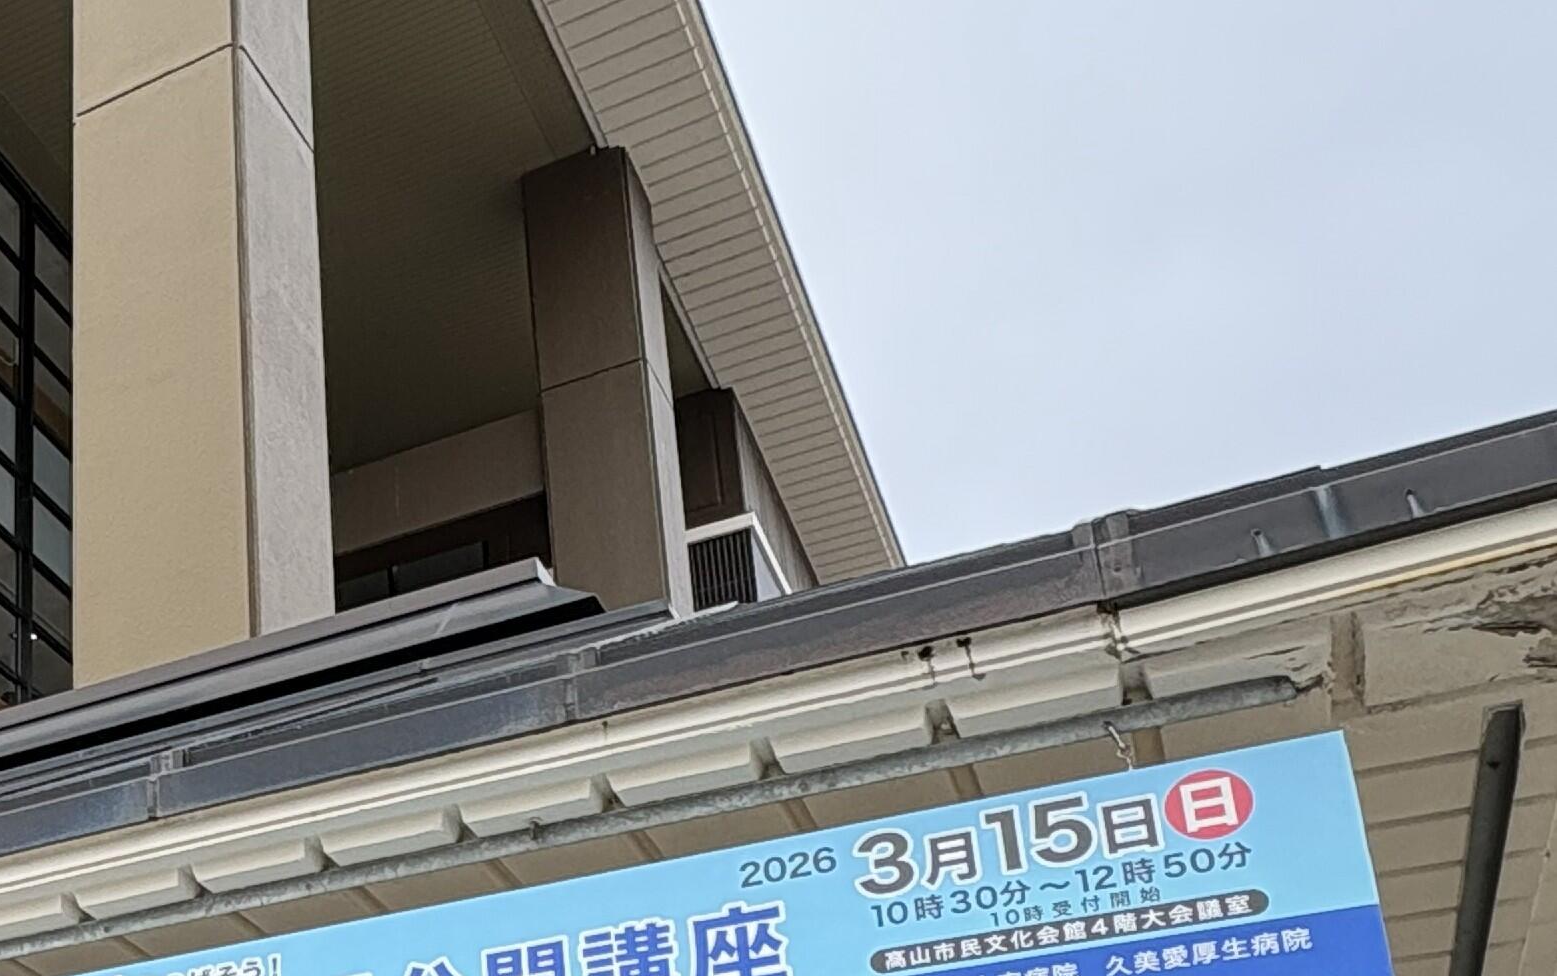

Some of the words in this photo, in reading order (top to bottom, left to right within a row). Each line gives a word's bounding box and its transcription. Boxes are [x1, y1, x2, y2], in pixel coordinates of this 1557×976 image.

[739, 847, 837, 888] 2026
[858, 796, 1160, 894] 3月15日
[1179, 776, 1238, 833] 日
[885, 894, 1252, 970] 高山市民文化会館4階大会議室
[990, 886, 1161, 926] 10時受付開始
